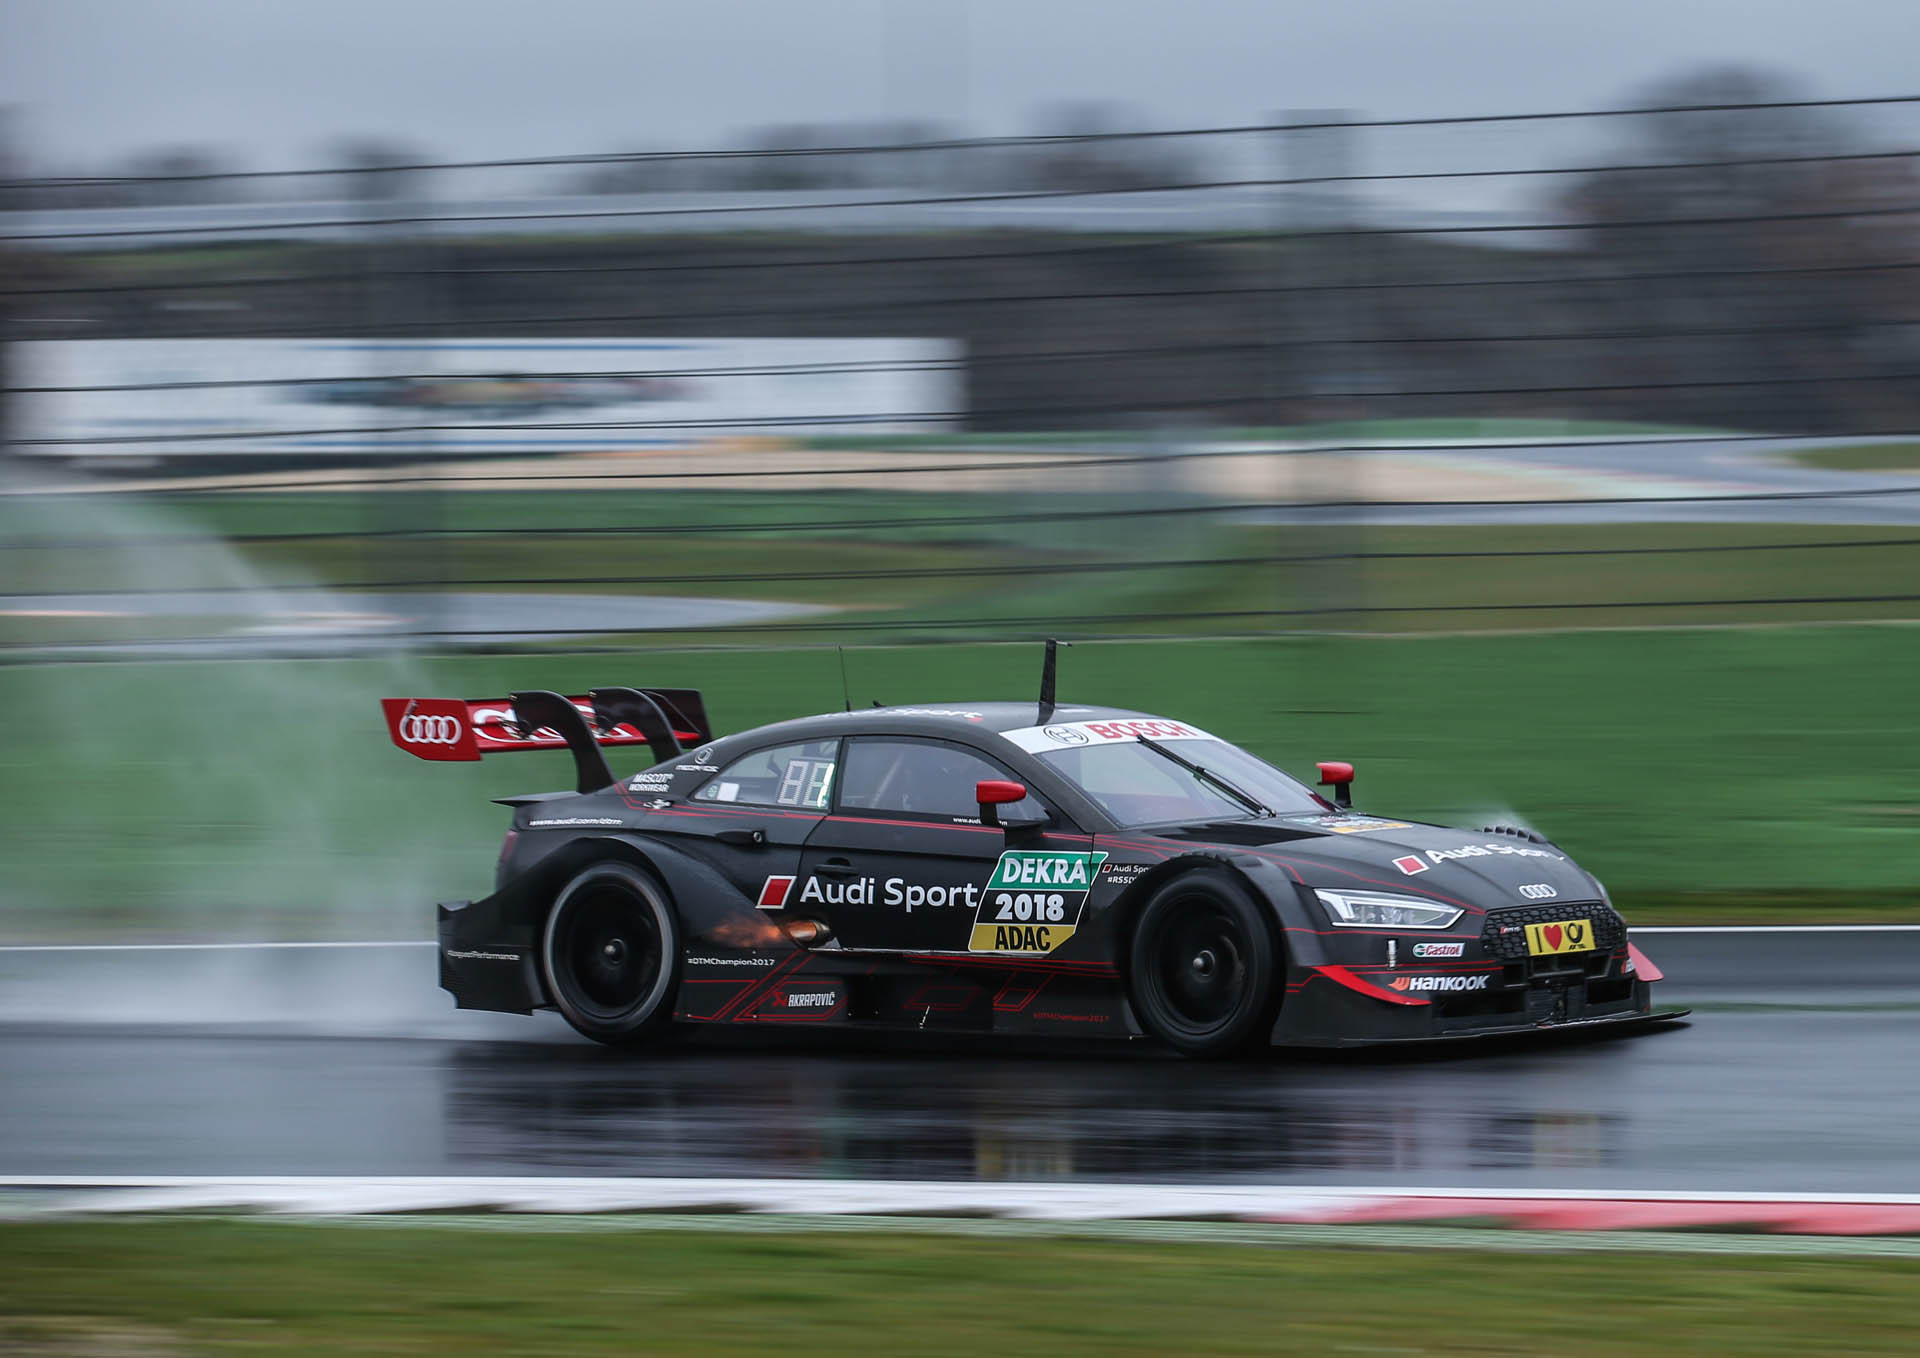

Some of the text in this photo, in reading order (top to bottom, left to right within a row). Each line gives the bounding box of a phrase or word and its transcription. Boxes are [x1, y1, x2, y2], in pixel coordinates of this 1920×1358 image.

[1084, 721, 1198, 739] BOSCH
[1002, 857, 1087, 885] DEKRA
[1112, 864, 1132, 873] Audi
[800, 876, 978, 913] Audi Sport
[994, 893, 1065, 921] 2018
[994, 925, 1051, 951] ADAC
[1425, 943, 1461, 956] Castrol
[687, 957, 775, 967] #DTMChampion2017
[788, 992, 835, 1007] AKRAPOVIČ
